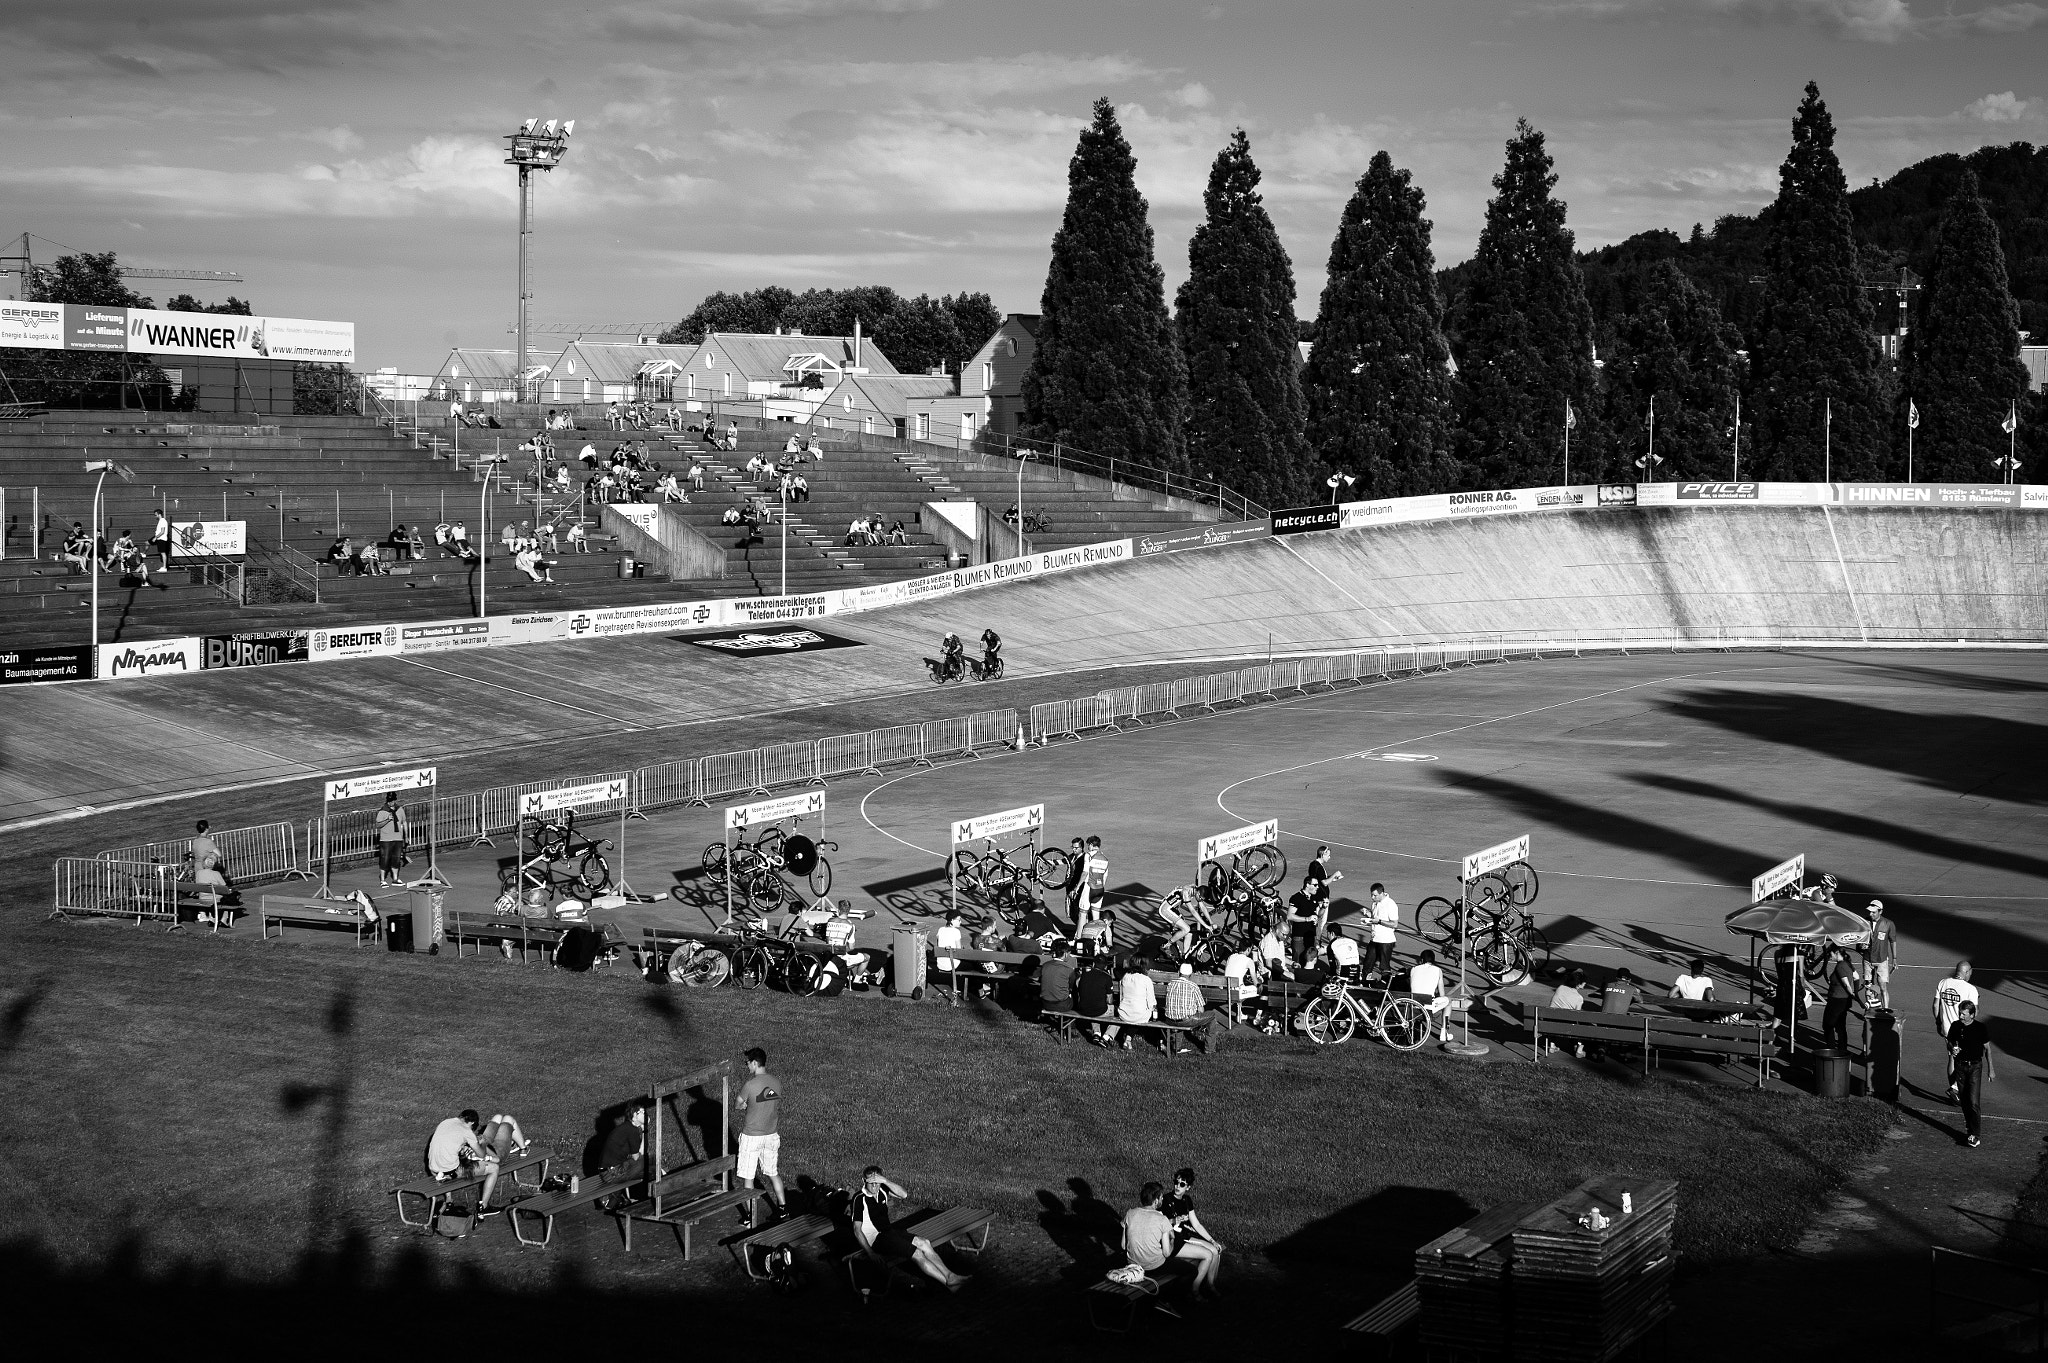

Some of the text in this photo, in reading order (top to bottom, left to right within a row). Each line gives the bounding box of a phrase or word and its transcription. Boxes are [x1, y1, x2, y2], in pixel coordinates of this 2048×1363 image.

[1, 308, 60, 318] GERBER
[85, 312, 124, 324] Lieferung
[2, 331, 21, 340] Energie
[29, 333, 49, 341] Logistik
[96, 326, 124, 336] Minute
[146, 323, 236, 350] WANNER
[272, 345, 353, 357] www.immerwanner.ch
[1599, 486, 1634, 501] KSD
[1849, 488, 1931, 501] HINNEN
[1979, 488, 2015, 496] Tiefbau
[1449, 493, 1493, 505] RONNER
[1942, 494, 2011, 504] 8153 Rümlang
[1352, 505, 1393, 517] weidmann
[1274, 511, 1339, 528] netcycle.ch
[1043, 545, 1123, 569] BLUMEN REMUND
[954, 560, 1032, 589] BLUMEN REMUND
[734, 597, 826, 610] www.schreinereikleger.ch
[596, 605, 688, 621] www.brunner-treuhand.com
[748, 605, 825, 620] Telefon 044 377 81 81
[512, 616, 554, 625] Elektro Zürichsee
[594, 617, 690, 634] Eingetragene Revisionsexperten
[232, 630, 298, 642] SCHRIFTBILDWERK.CH
[423, 627, 454, 637] Haustechnik
[455, 626, 464, 634] AG
[330, 631, 382, 648] BEREUTER
[5, 664, 78, 678] Baumanagement AG
